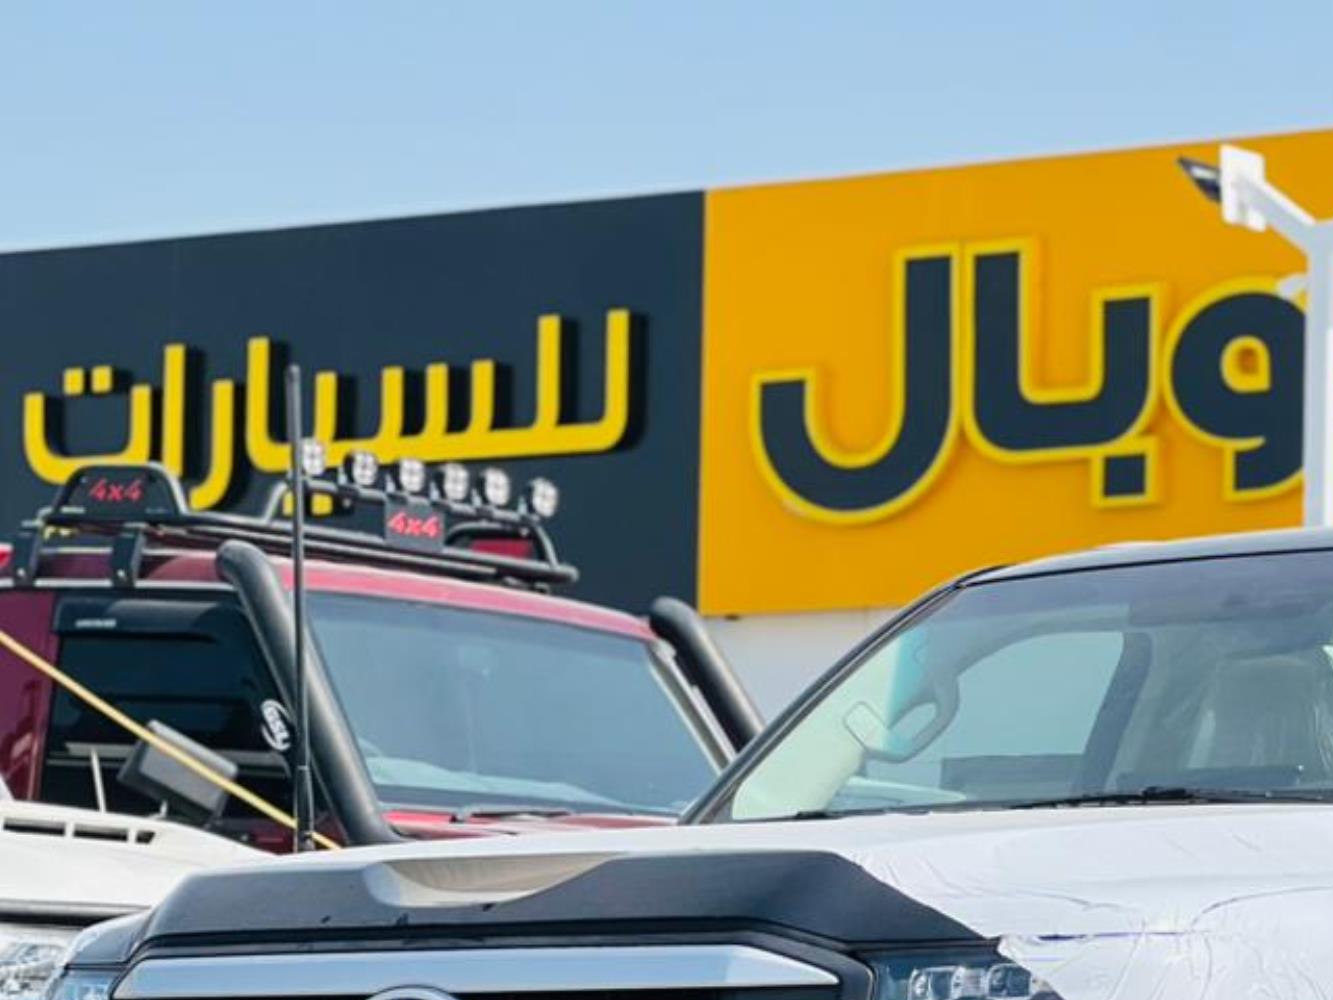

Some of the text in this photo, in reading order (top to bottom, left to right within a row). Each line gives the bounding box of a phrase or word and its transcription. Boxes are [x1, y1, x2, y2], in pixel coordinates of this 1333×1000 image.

[23, 309, 630, 516] للسيارات
[89, 480, 143, 502] 4x4
[387, 511, 442, 538] 4x4
